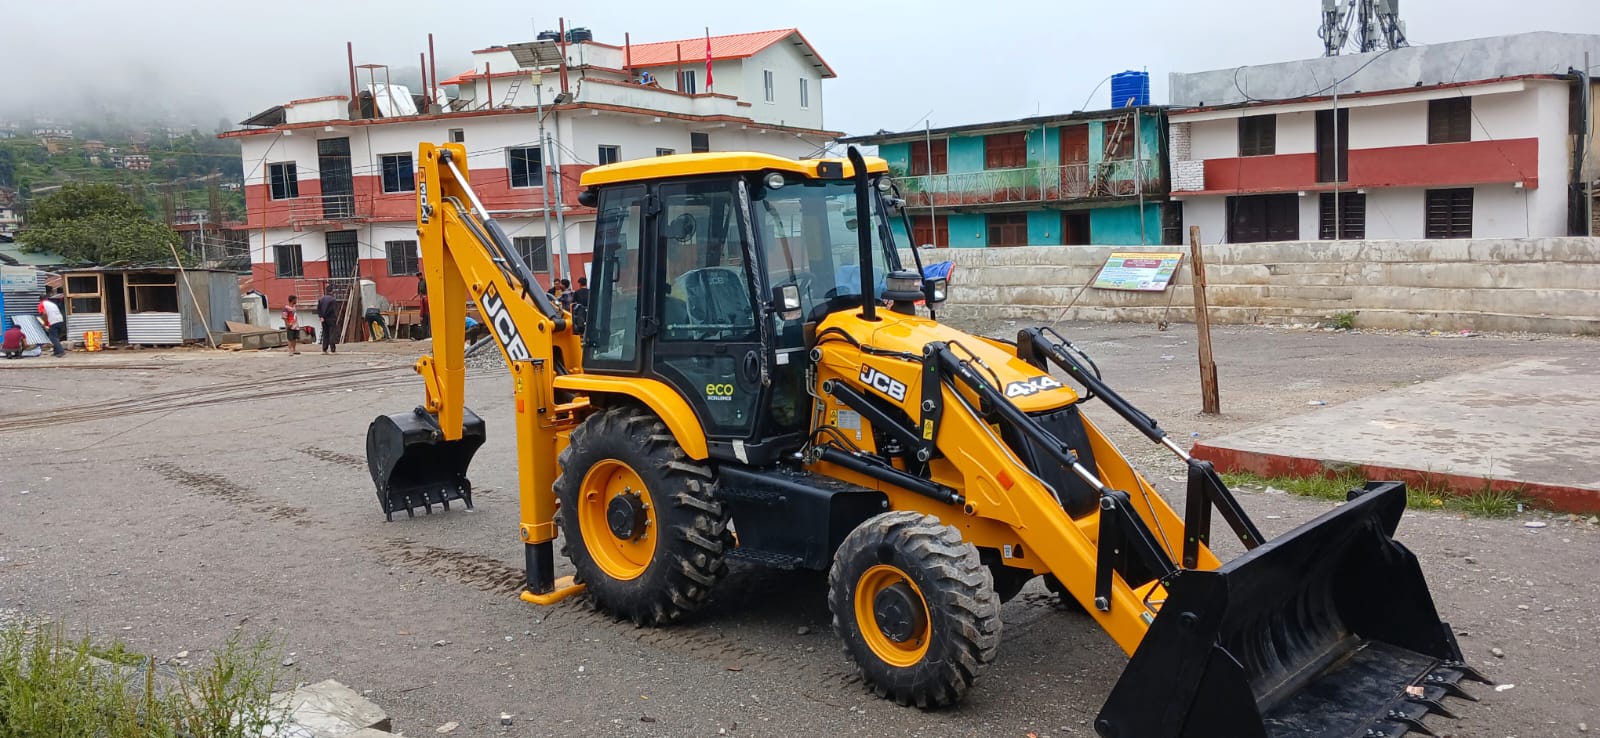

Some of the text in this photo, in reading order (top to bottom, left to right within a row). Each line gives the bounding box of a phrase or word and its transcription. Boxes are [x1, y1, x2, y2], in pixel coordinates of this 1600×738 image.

[482, 292, 530, 360] JCB
[705, 383, 734, 396] eco
[860, 368, 906, 401] JCB
